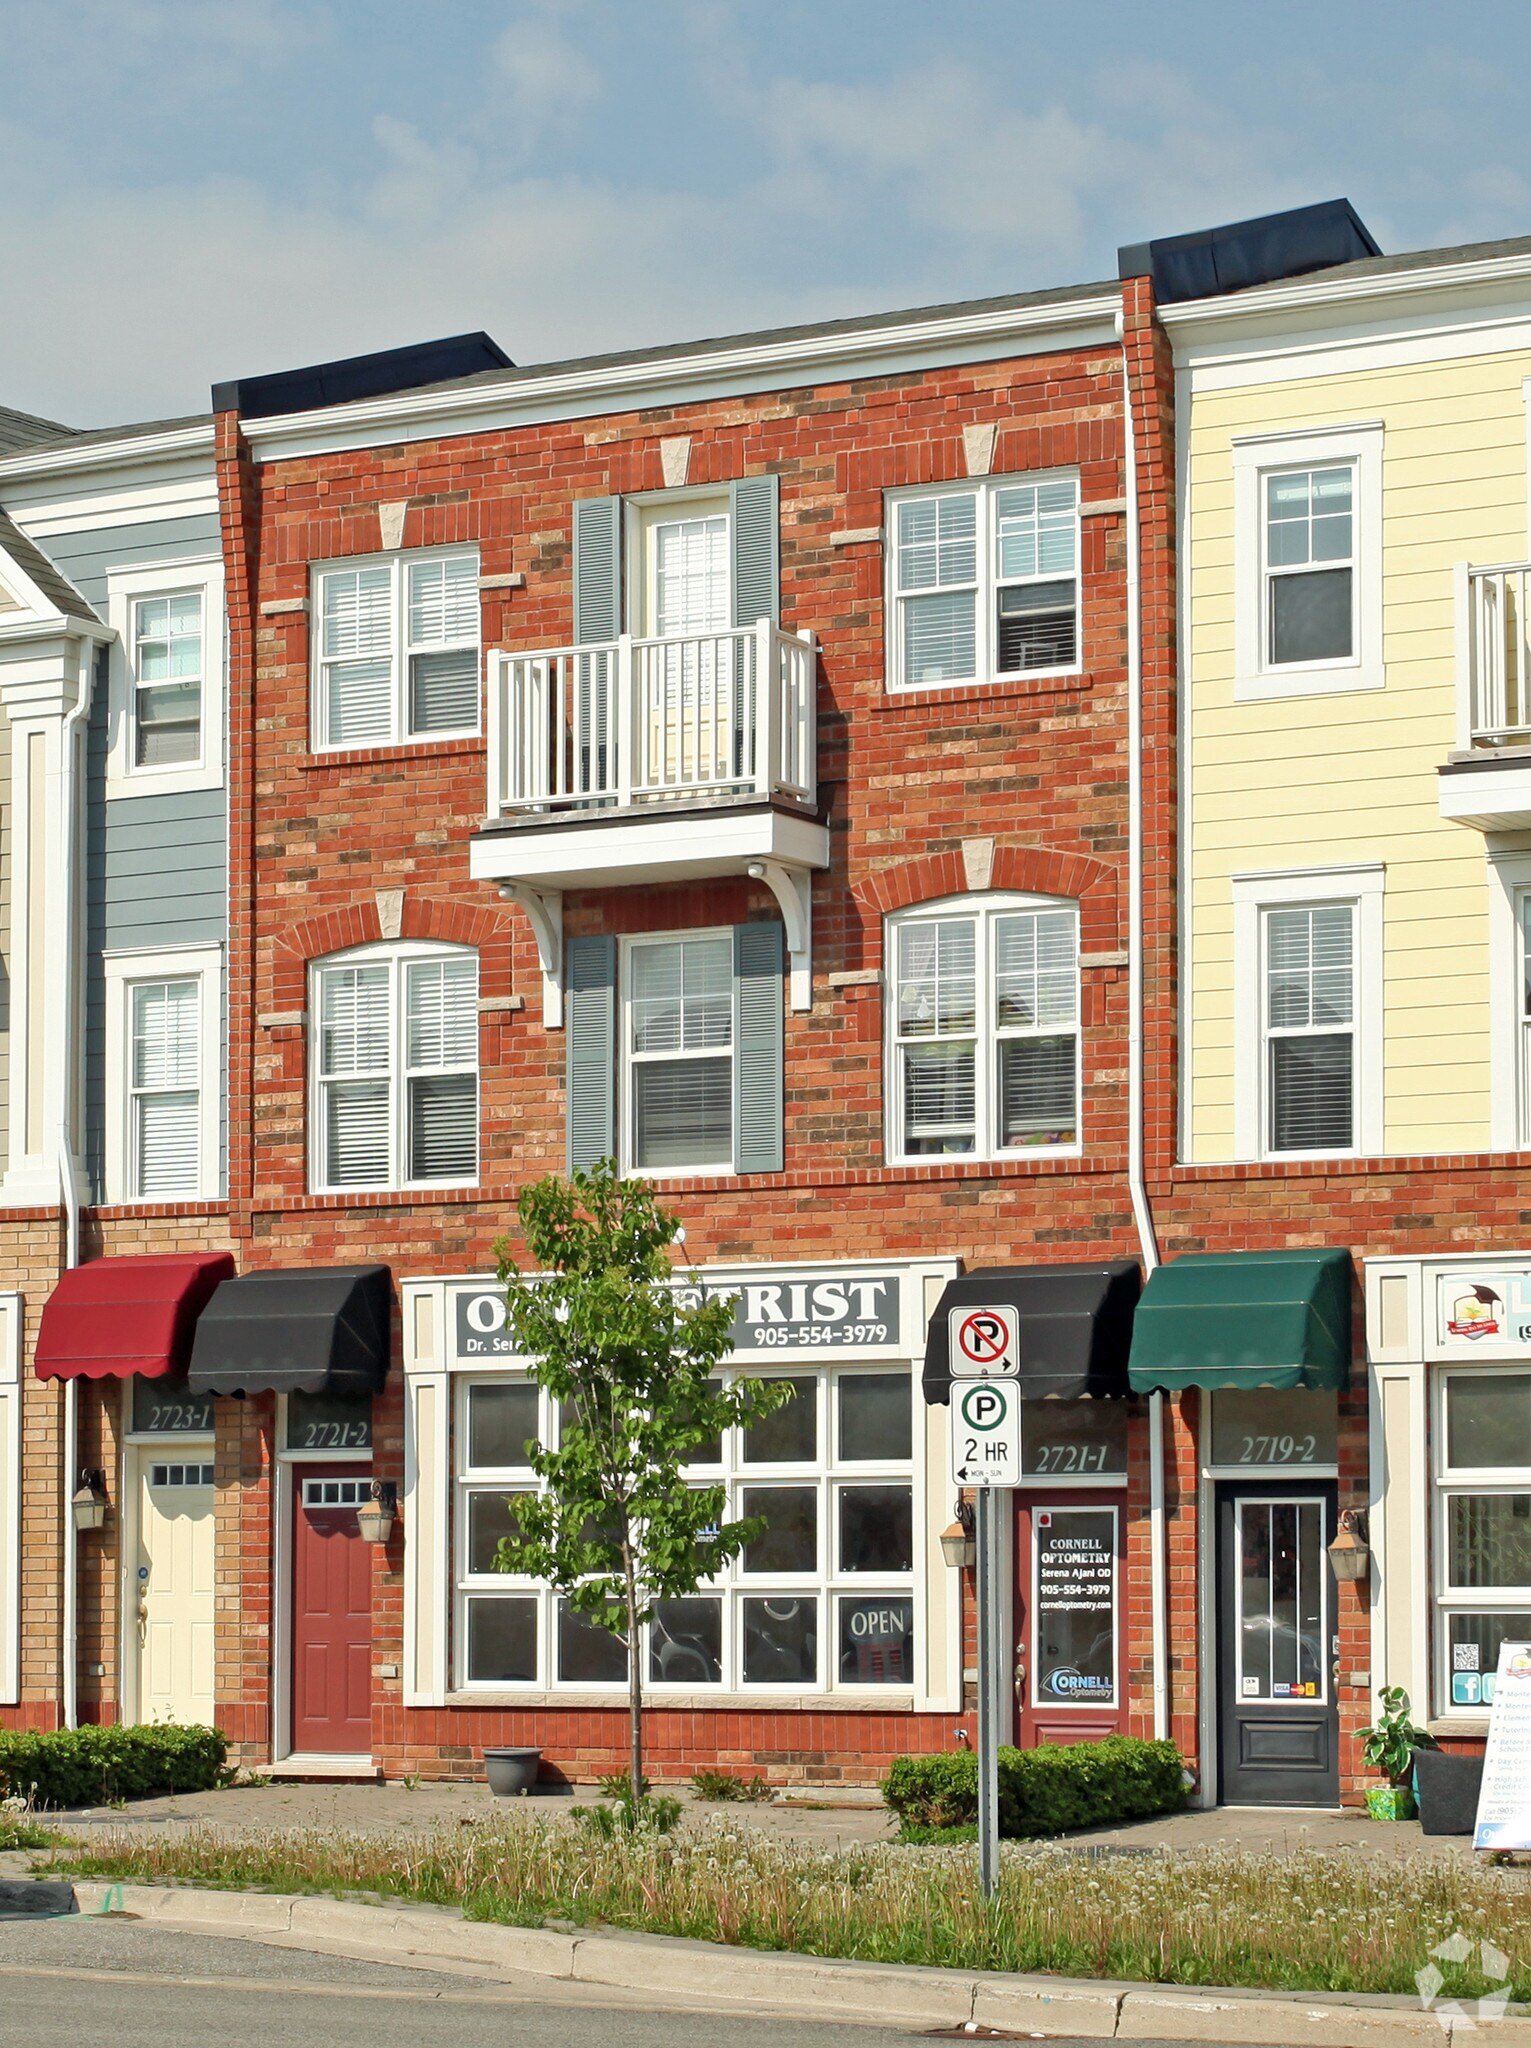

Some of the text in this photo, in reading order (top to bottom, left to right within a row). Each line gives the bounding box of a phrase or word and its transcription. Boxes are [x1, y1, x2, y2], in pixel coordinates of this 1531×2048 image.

[466, 1338, 487, 1352] Dr.
[754, 1324, 888, 1346] 905-554-3979
[149, 1405, 210, 1429] 2723-1
[304, 1422, 368, 1447] 2721-2
[965, 1438, 1008, 1462] 2 HR
[1035, 1445, 1107, 1472] 2721-1
[1239, 1434, 1316, 1462] 2719-2
[1050, 1539, 1102, 1550] CORNELL
[1041, 1552, 1111, 1564] OPTOMETRY
[1041, 1568, 1070, 1578] Serena
[1097, 1568, 1111, 1578] OD
[1040, 1584, 1111, 1595] 905-554-3979
[1040, 1600, 1111, 1612] cornelloptometry.com
[850, 1609, 904, 1636] OPEN
[1051, 1669, 1113, 1696] CORNELL
[1069, 1688, 1113, 1699] Optometry
